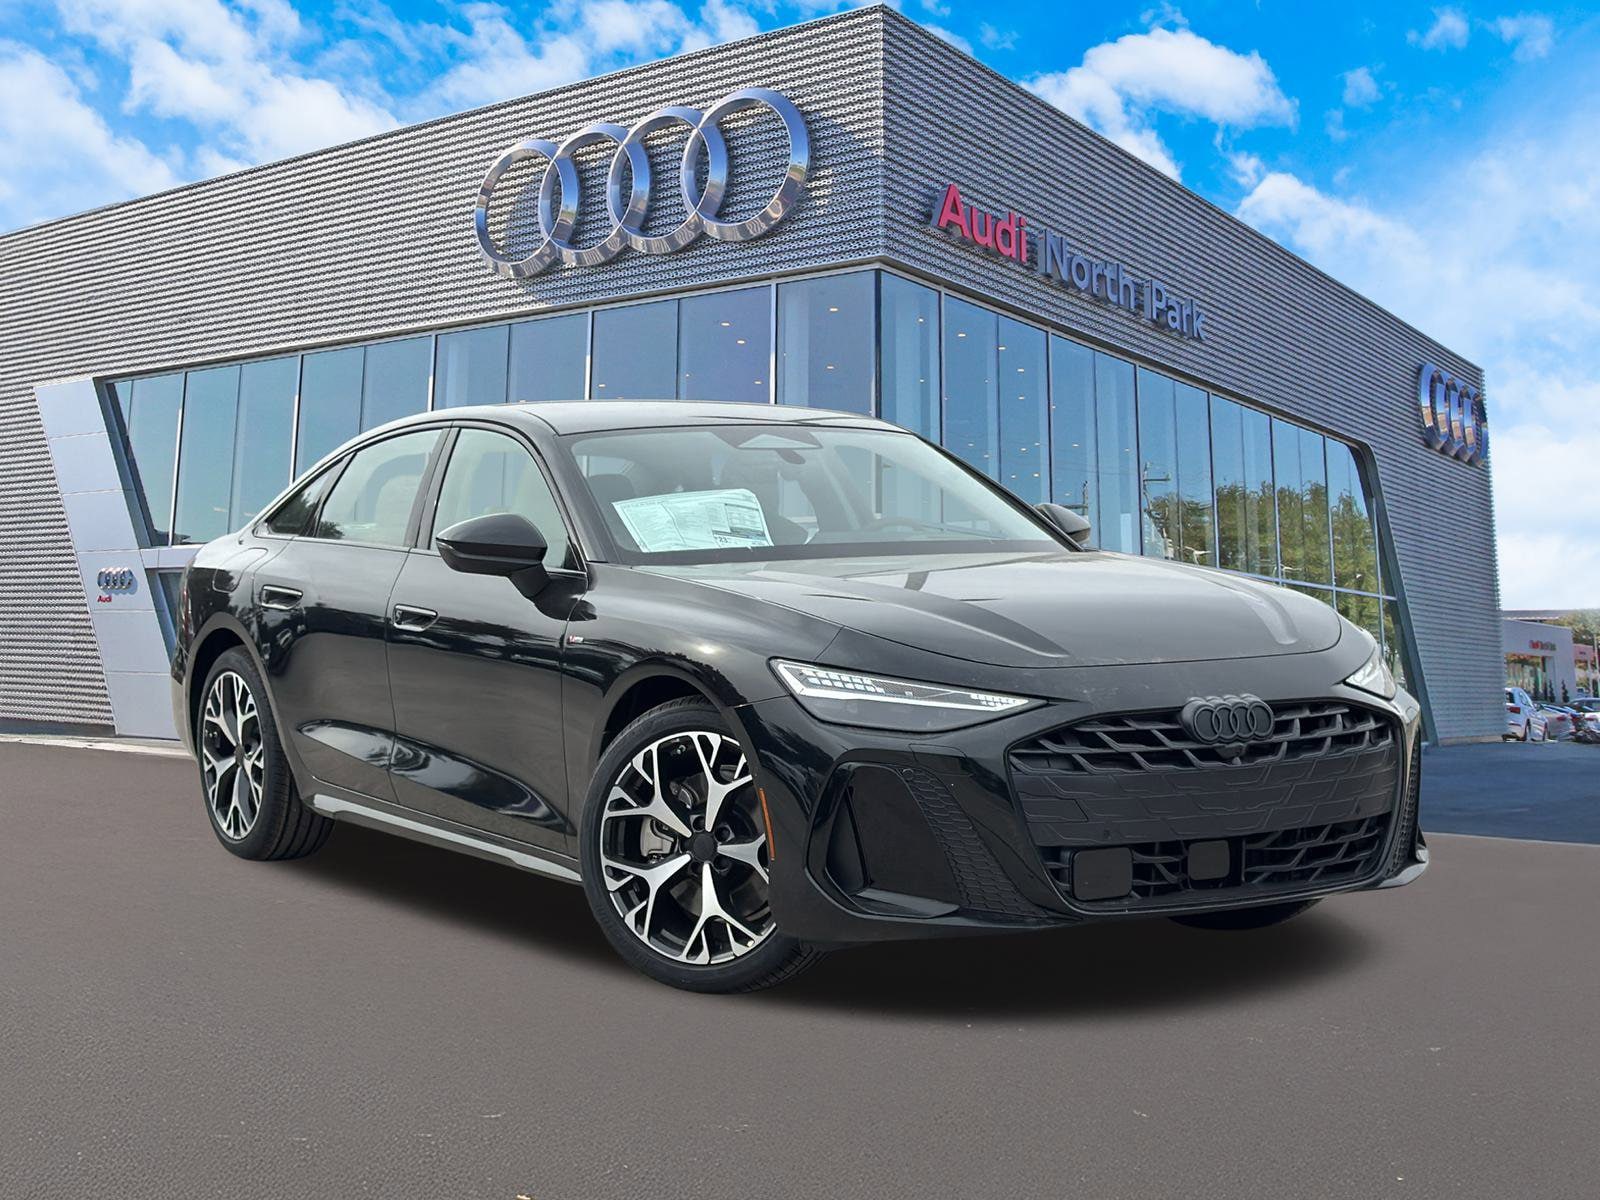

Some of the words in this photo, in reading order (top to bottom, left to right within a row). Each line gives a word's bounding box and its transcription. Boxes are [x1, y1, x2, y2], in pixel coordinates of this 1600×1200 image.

[932, 183, 1028, 264] Audi
[1041, 229, 1136, 311] North
[1146, 279, 1207, 341] Park
